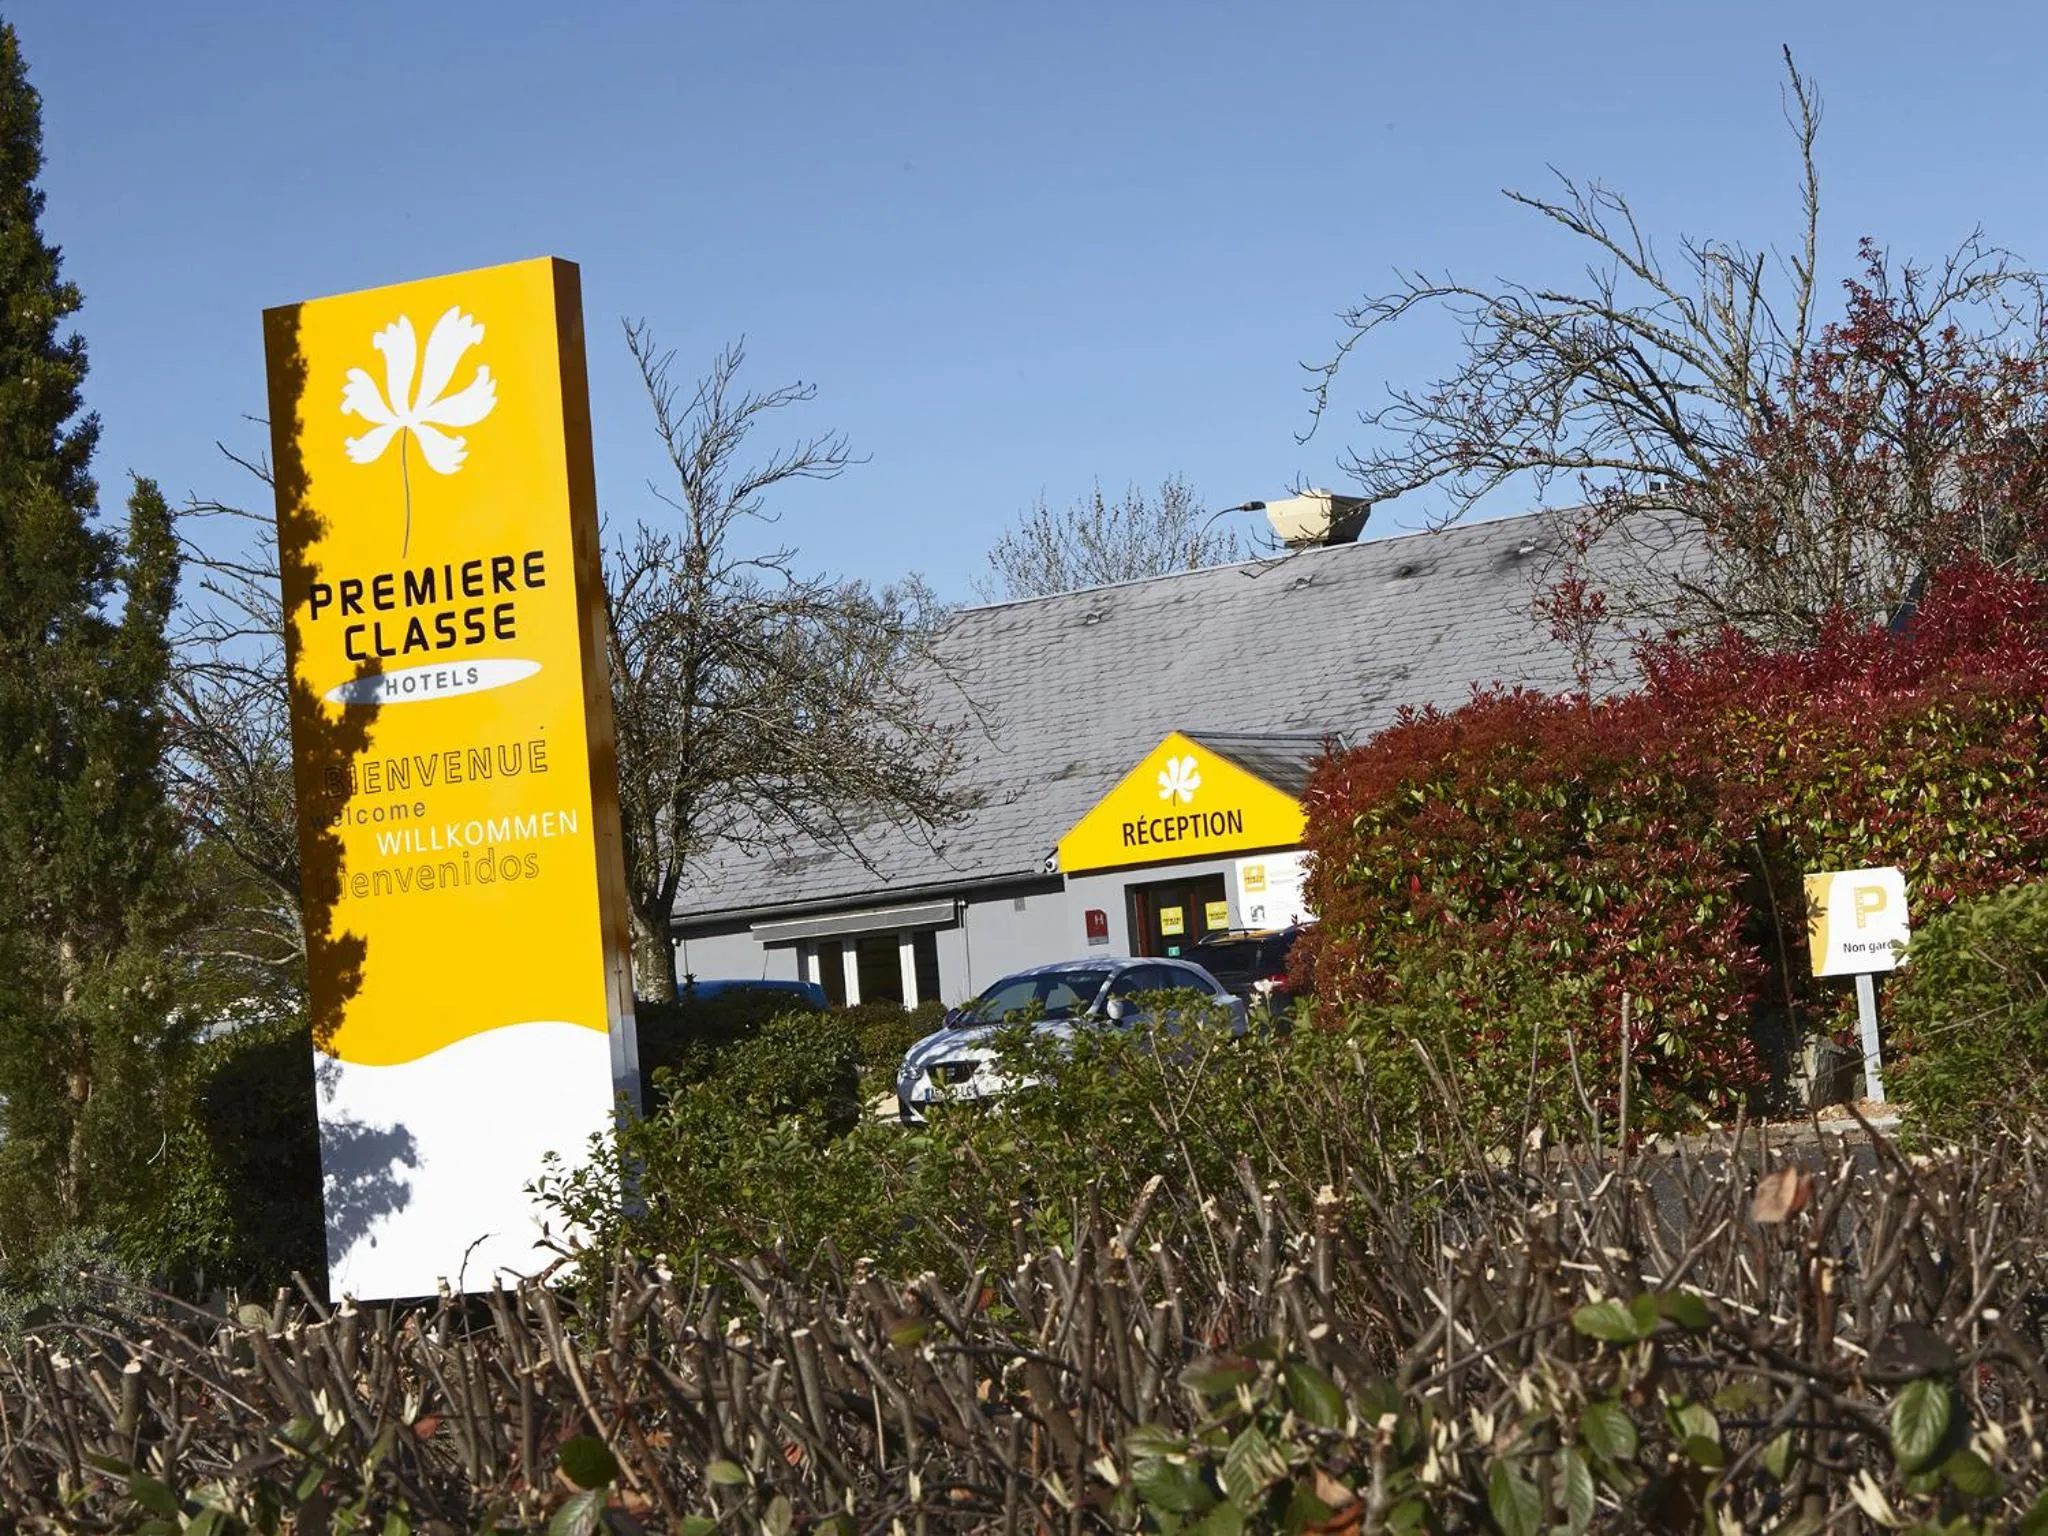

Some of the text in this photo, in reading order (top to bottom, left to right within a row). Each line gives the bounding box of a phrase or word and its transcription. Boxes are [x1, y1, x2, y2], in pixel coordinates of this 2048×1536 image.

[310, 550, 546, 621] PREMIERE
[344, 602, 516, 661] CLASSE
[385, 667, 479, 696] HOTELS
[323, 739, 548, 798] BIENVENUE
[376, 809, 578, 856] WILLKOMMEN
[1122, 809, 1243, 847] RÉCEPTION
[1854, 885, 1887, 929] P
[1843, 941, 1866, 953] Non
